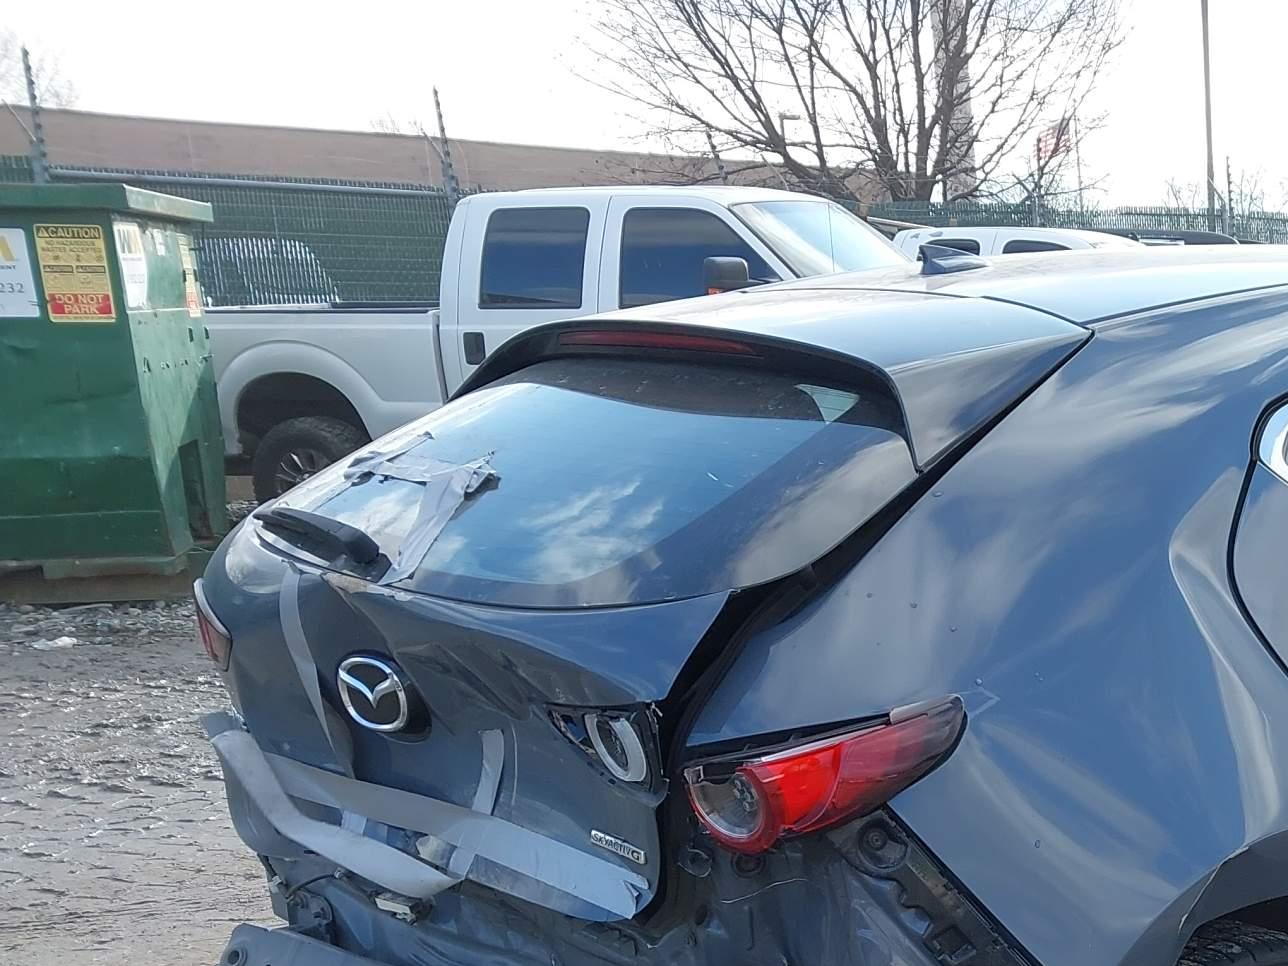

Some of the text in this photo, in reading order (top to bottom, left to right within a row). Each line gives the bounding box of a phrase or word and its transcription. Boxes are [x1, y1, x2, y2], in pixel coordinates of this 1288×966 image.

[47, 227, 99, 238] CAUTION
[54, 294, 105, 304] DO NOT
[64, 304, 100, 314] PARK
